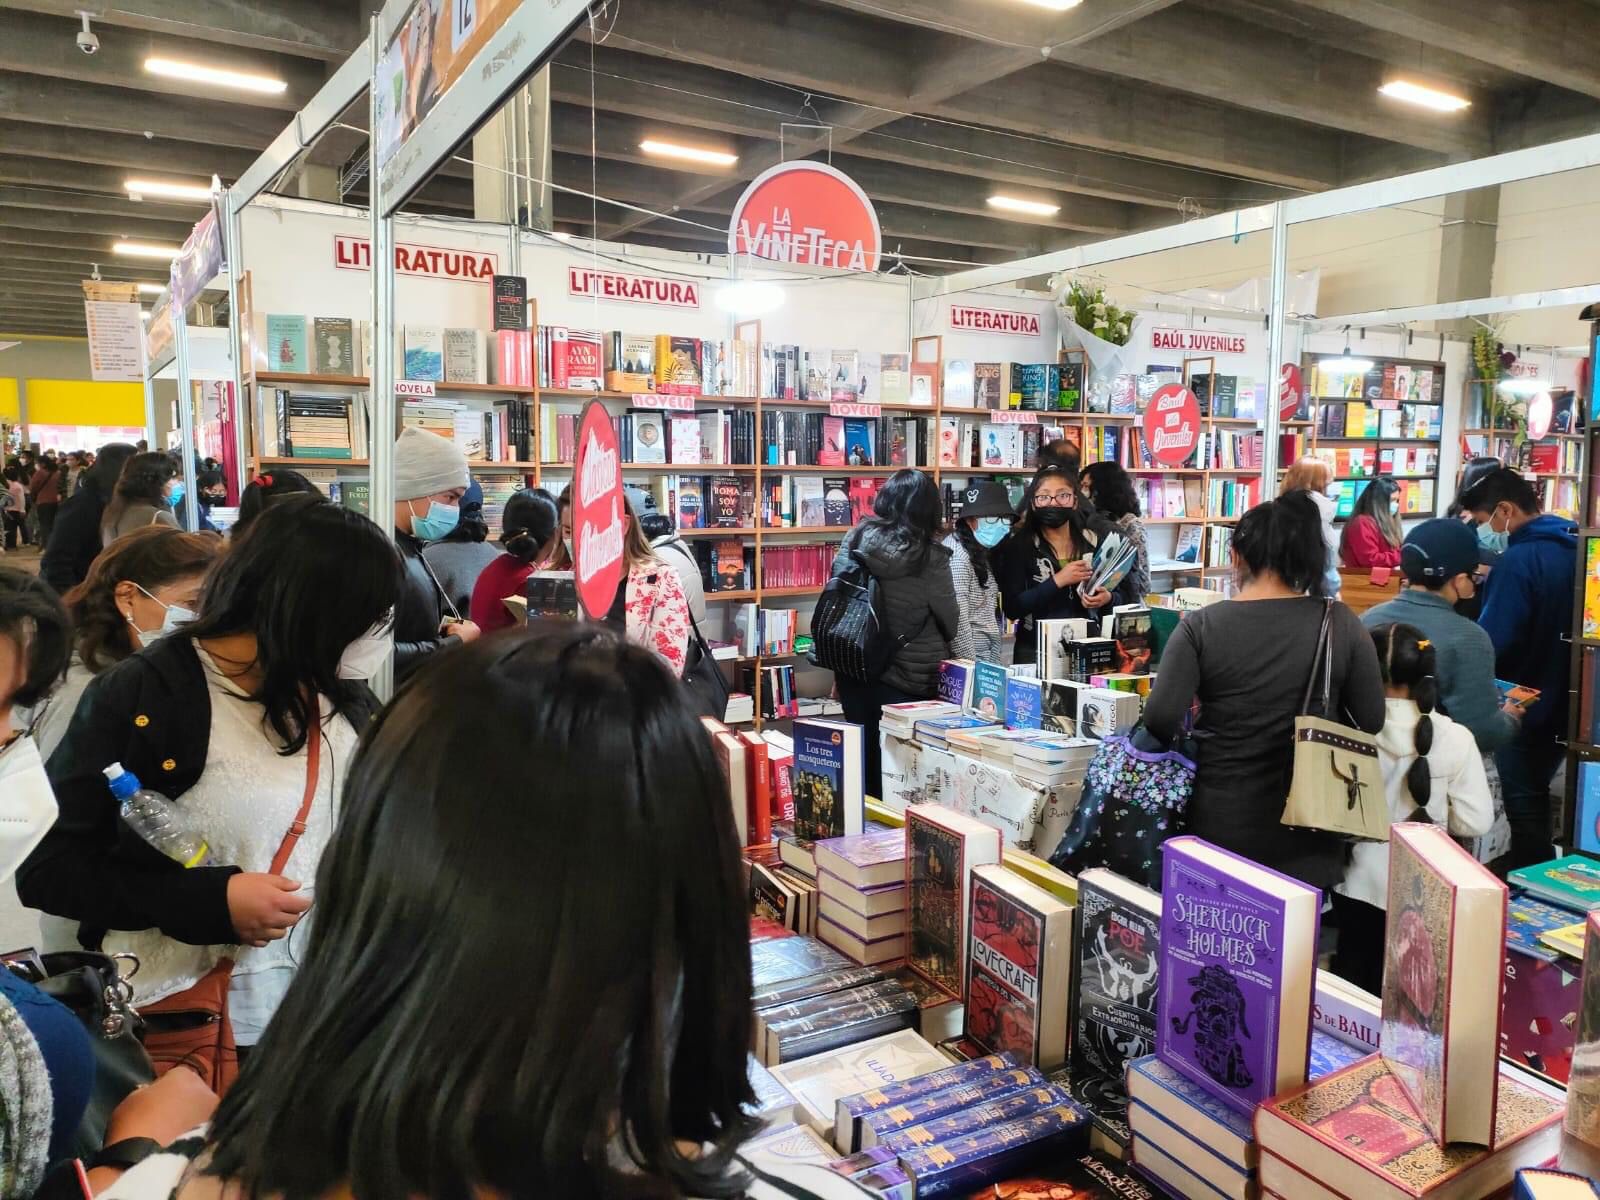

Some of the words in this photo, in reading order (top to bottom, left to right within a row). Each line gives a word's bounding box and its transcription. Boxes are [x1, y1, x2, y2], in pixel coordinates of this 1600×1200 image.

[773, 206, 792, 226] LA
[337, 240, 495, 279] LITRATURA
[570, 270, 698, 306] LITERATURA
[951, 308, 1040, 333] LITERATURA
[570, 346, 591, 356] AYN
[1153, 330, 1187, 349] BAÚL
[1188, 334, 1246, 353] JUVENILES
[633, 394, 695, 409] NOVELA
[831, 404, 881, 416] NOVELA
[992, 411, 1038, 423] NOVELA
[721, 508, 734, 516] YO
[806, 742, 819, 755] Los
[820, 747, 833, 757] tres
[798, 753, 841, 769] mosqueteros
[1172, 893, 1276, 951] SHERLOCK
[1107, 921, 1147, 956] POE
[1186, 924, 1256, 966] HOLMES
[973, 938, 1037, 999] LOVECRAFT
[1107, 1003, 1140, 1022] CUENTOS
[1324, 1014, 1336, 1028] DE
